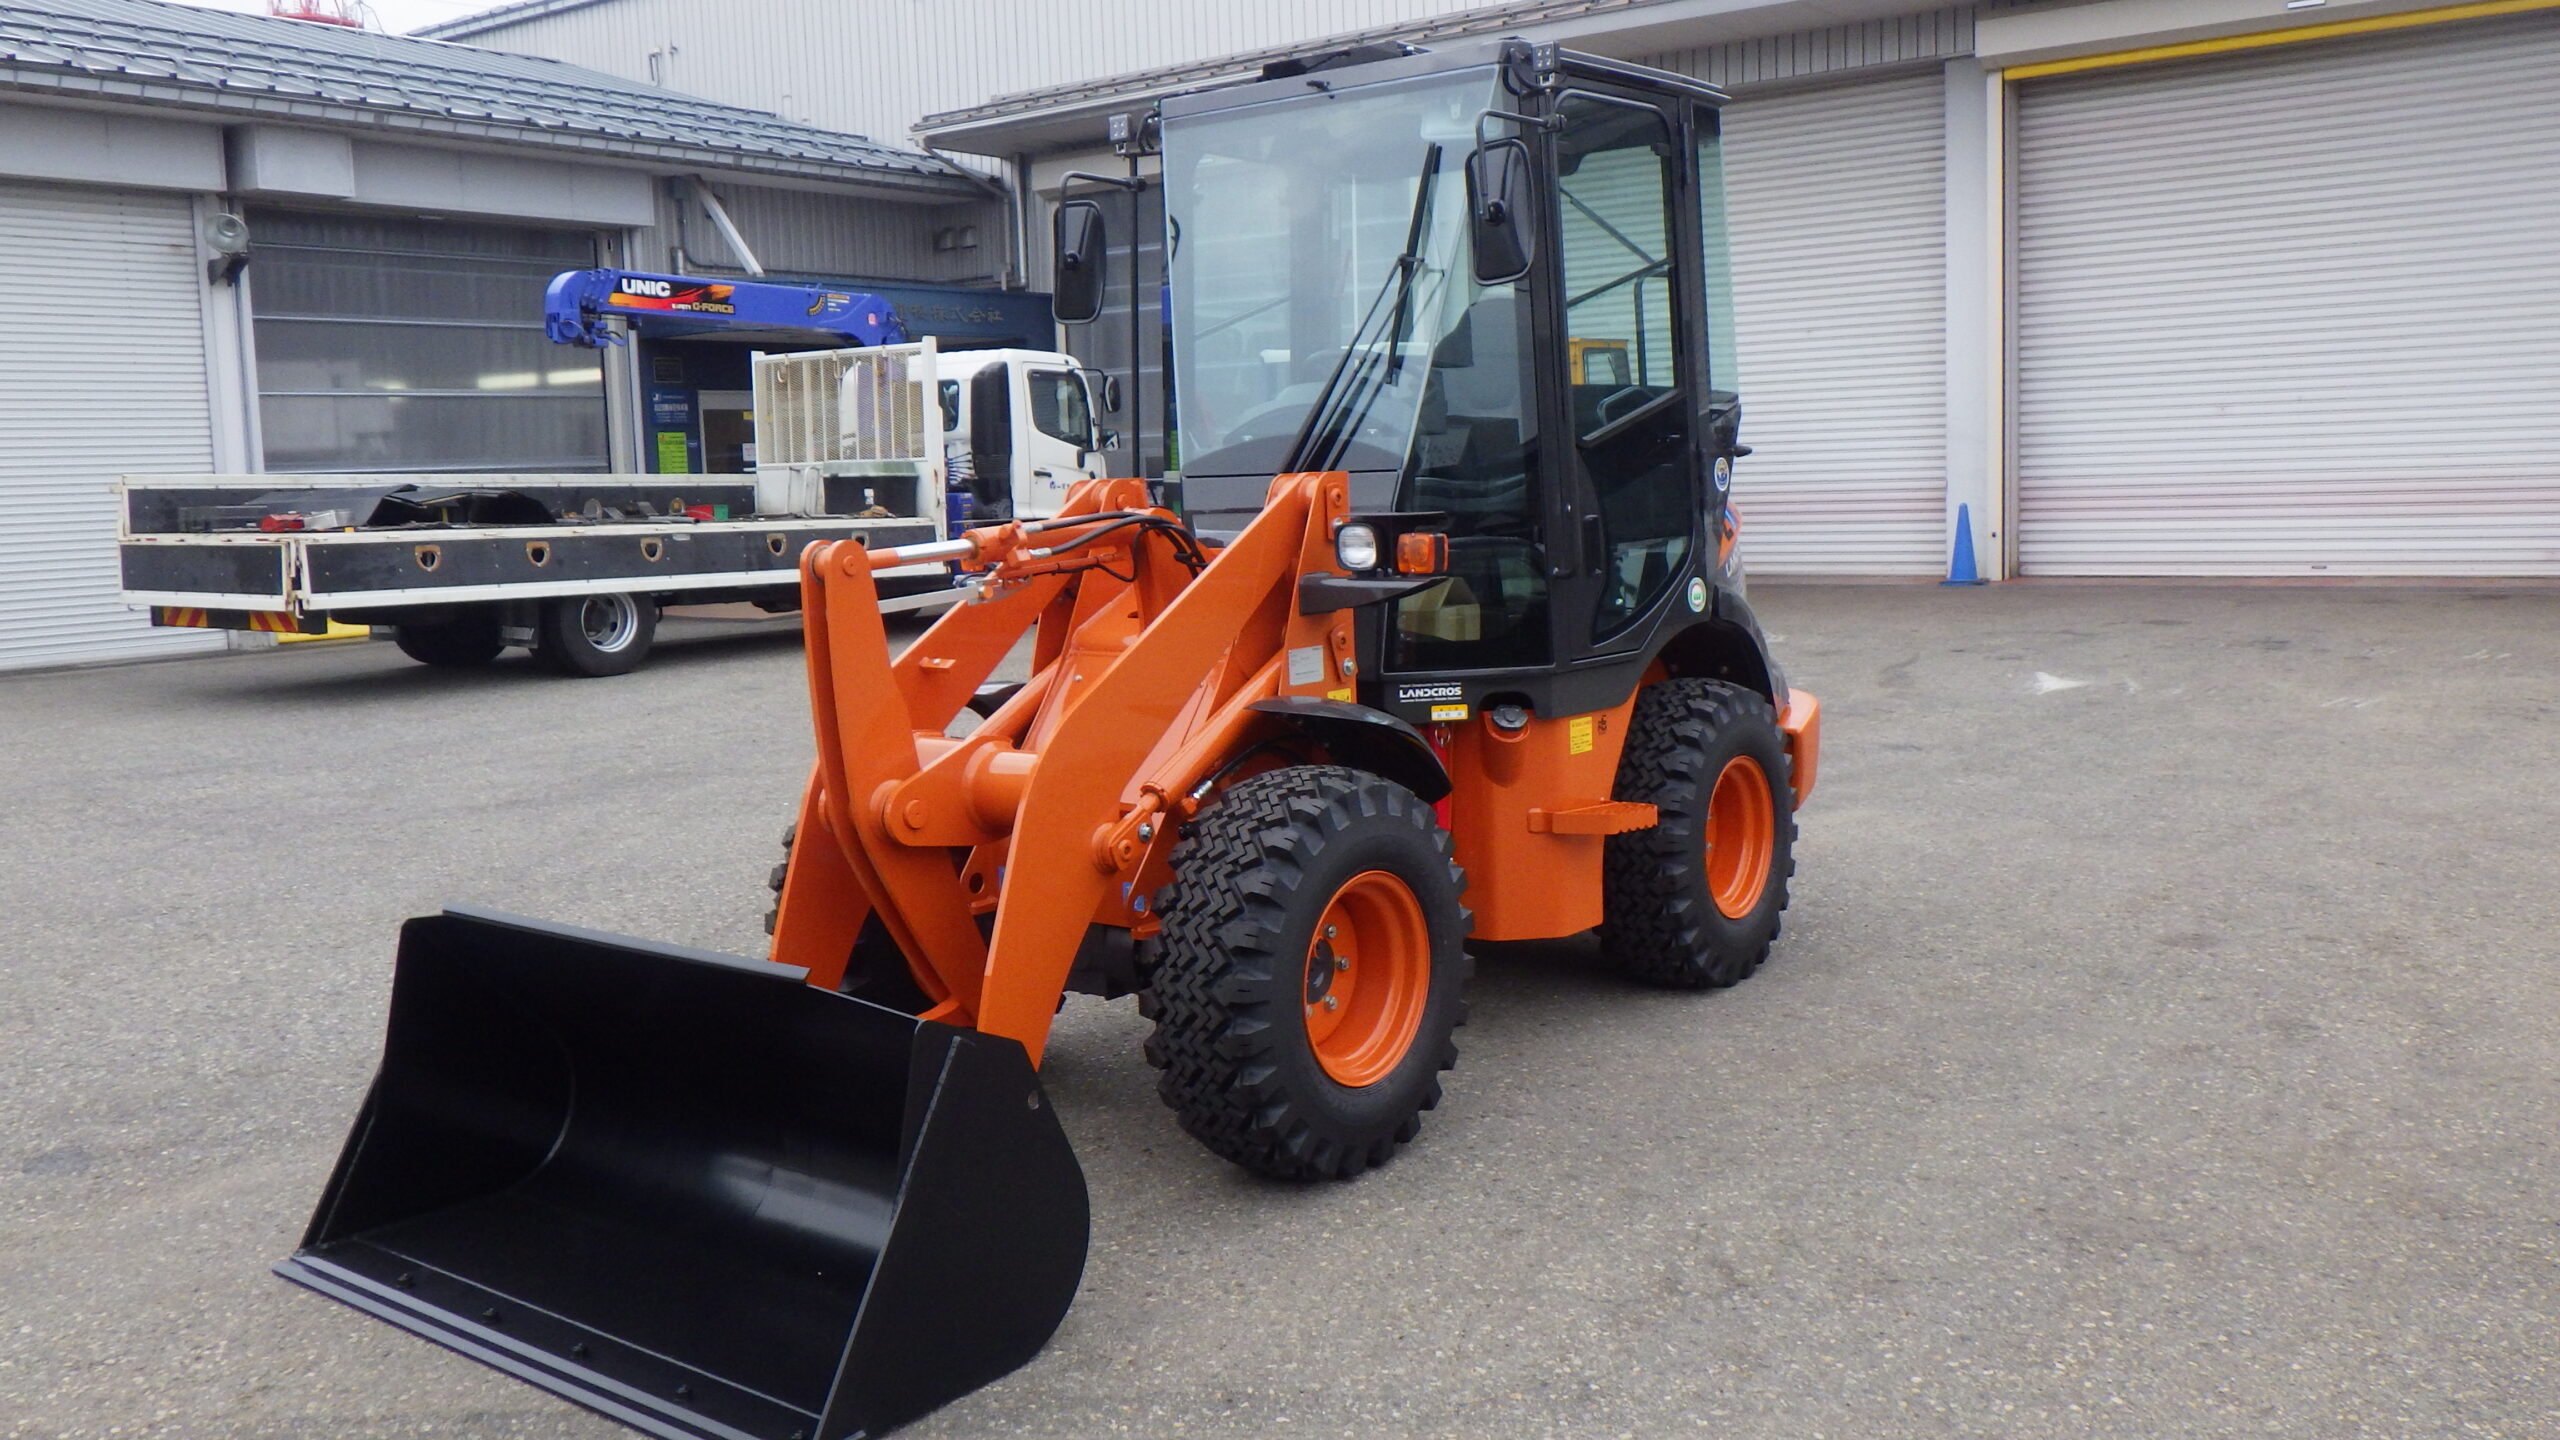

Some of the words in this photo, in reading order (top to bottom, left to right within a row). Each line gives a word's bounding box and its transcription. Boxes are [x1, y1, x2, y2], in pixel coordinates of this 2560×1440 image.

[621, 278, 670, 297] UNIC
[692, 302, 735, 314] G-FORCE
[1399, 687, 1462, 698] LANDCROS
